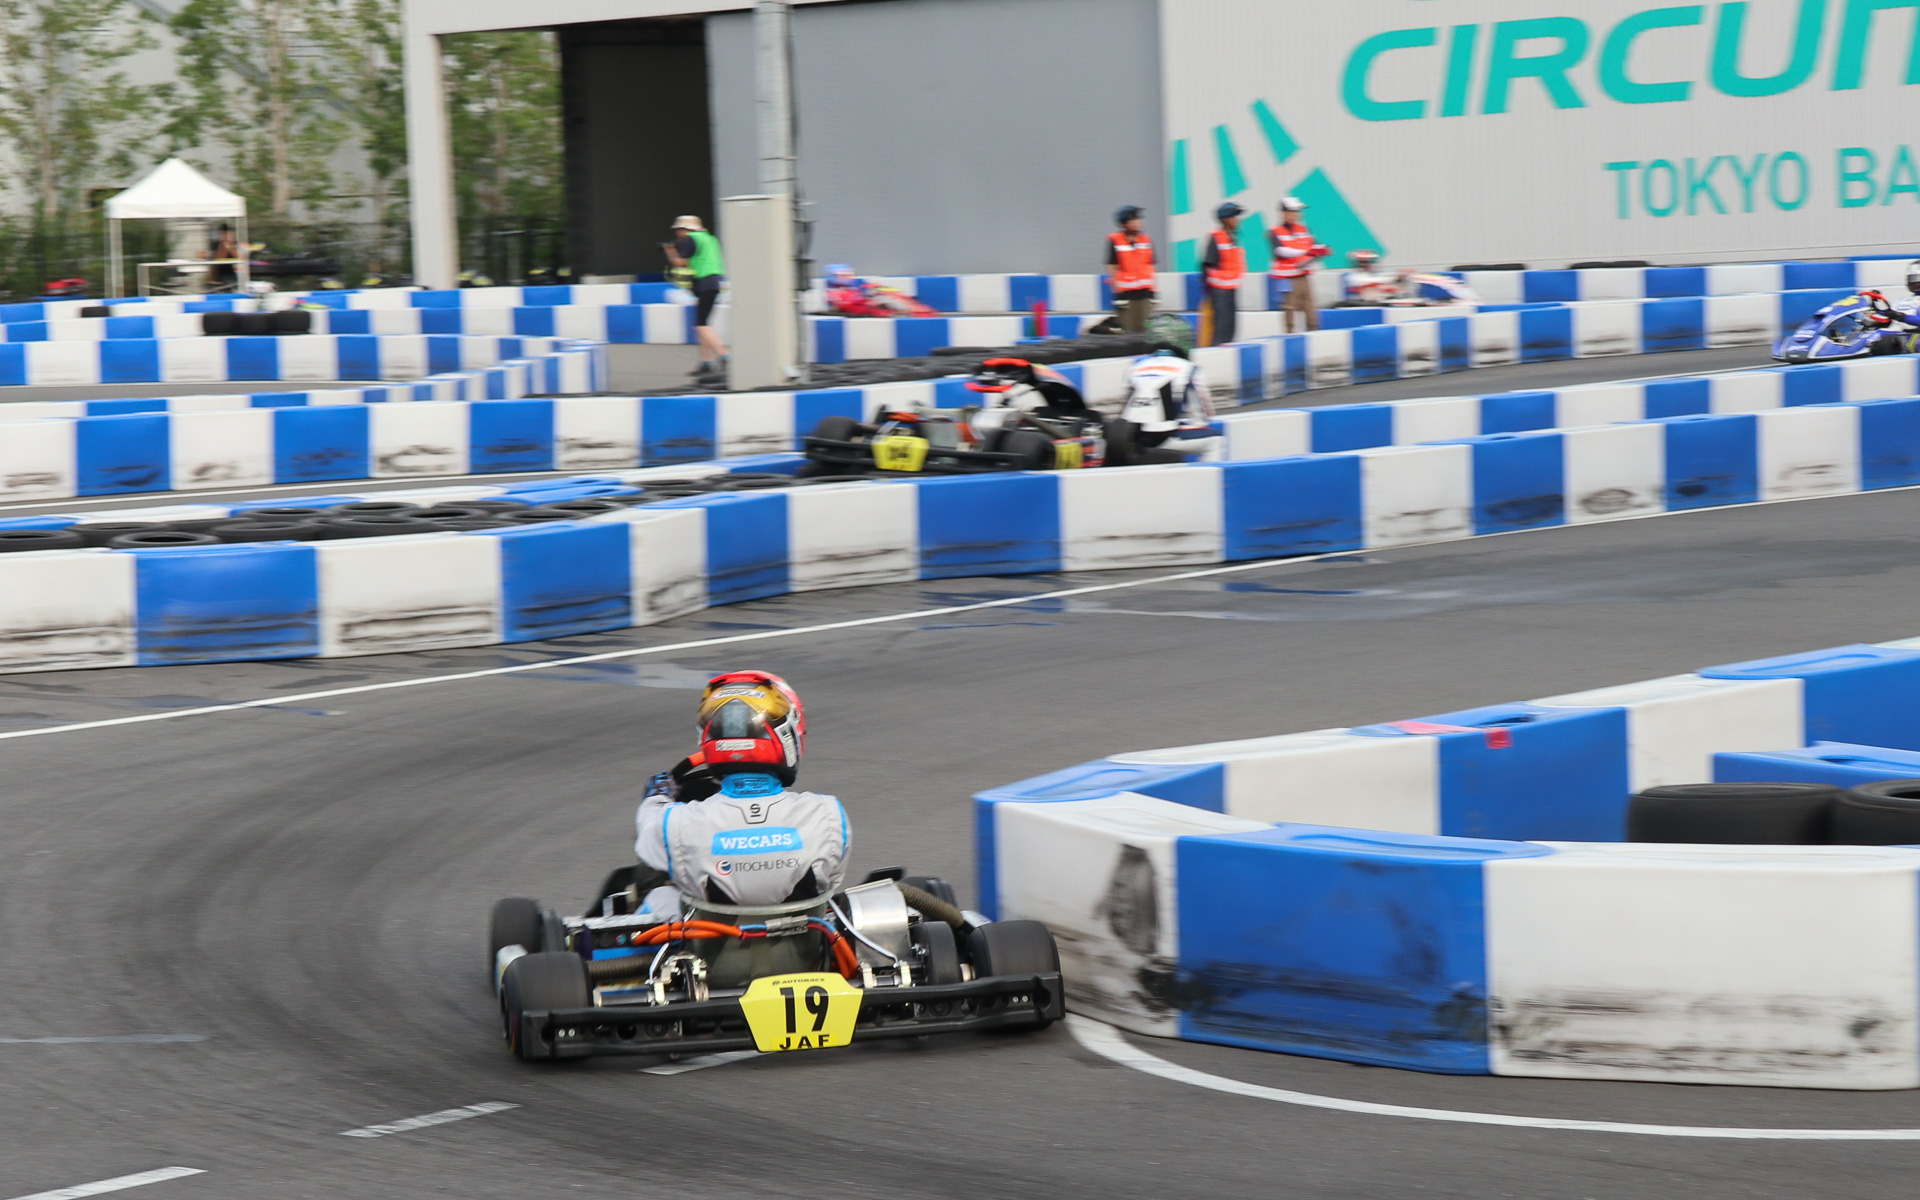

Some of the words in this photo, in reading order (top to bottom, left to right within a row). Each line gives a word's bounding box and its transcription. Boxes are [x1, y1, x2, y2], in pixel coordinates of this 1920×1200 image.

[1603, 150, 1811, 220] TOKYO
[719, 833, 793, 850] WECARS
[735, 860, 774, 873] ITOCHU
[775, 857, 800, 871] ENEX
[779, 985, 829, 1034] 19
[778, 1034, 830, 1051] JAF
